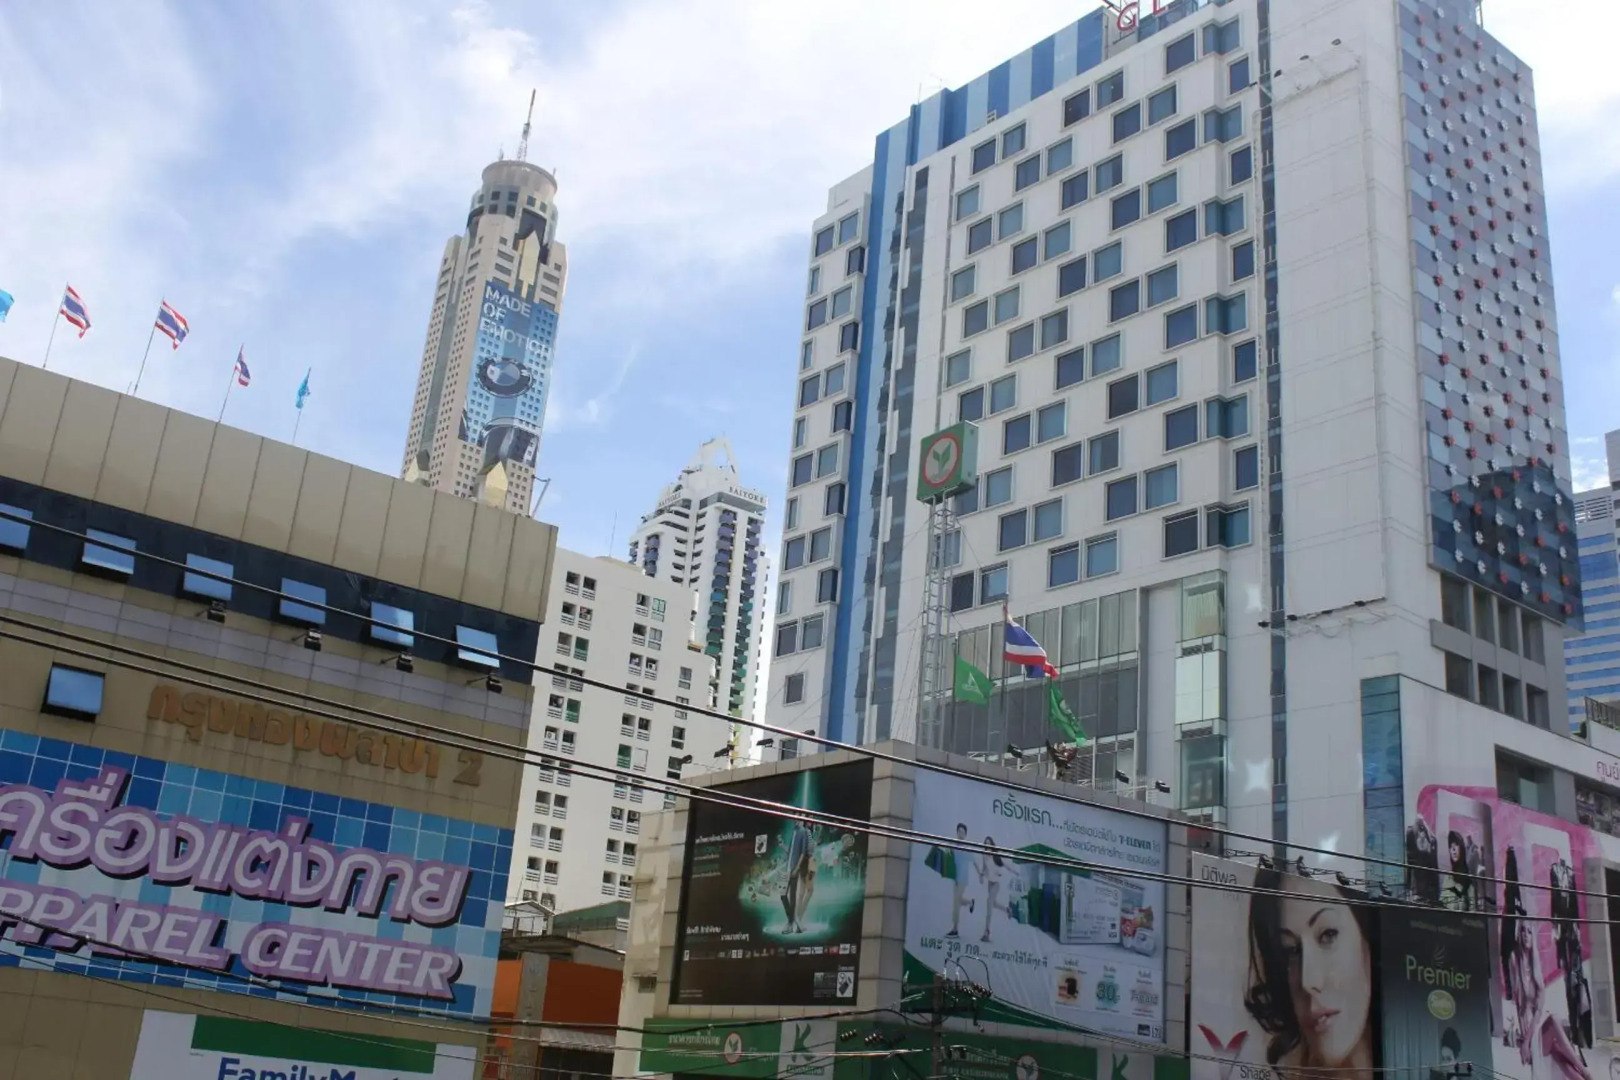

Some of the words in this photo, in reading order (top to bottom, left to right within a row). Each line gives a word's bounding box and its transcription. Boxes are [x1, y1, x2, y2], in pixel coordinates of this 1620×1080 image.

[483, 302, 507, 319] OF
[485, 286, 532, 317] MADE
[479, 318, 552, 356] EMOTION
[453, 751, 483, 787] 2
[245, 926, 456, 999] CENTER
[1406, 954, 1473, 990] Premier
